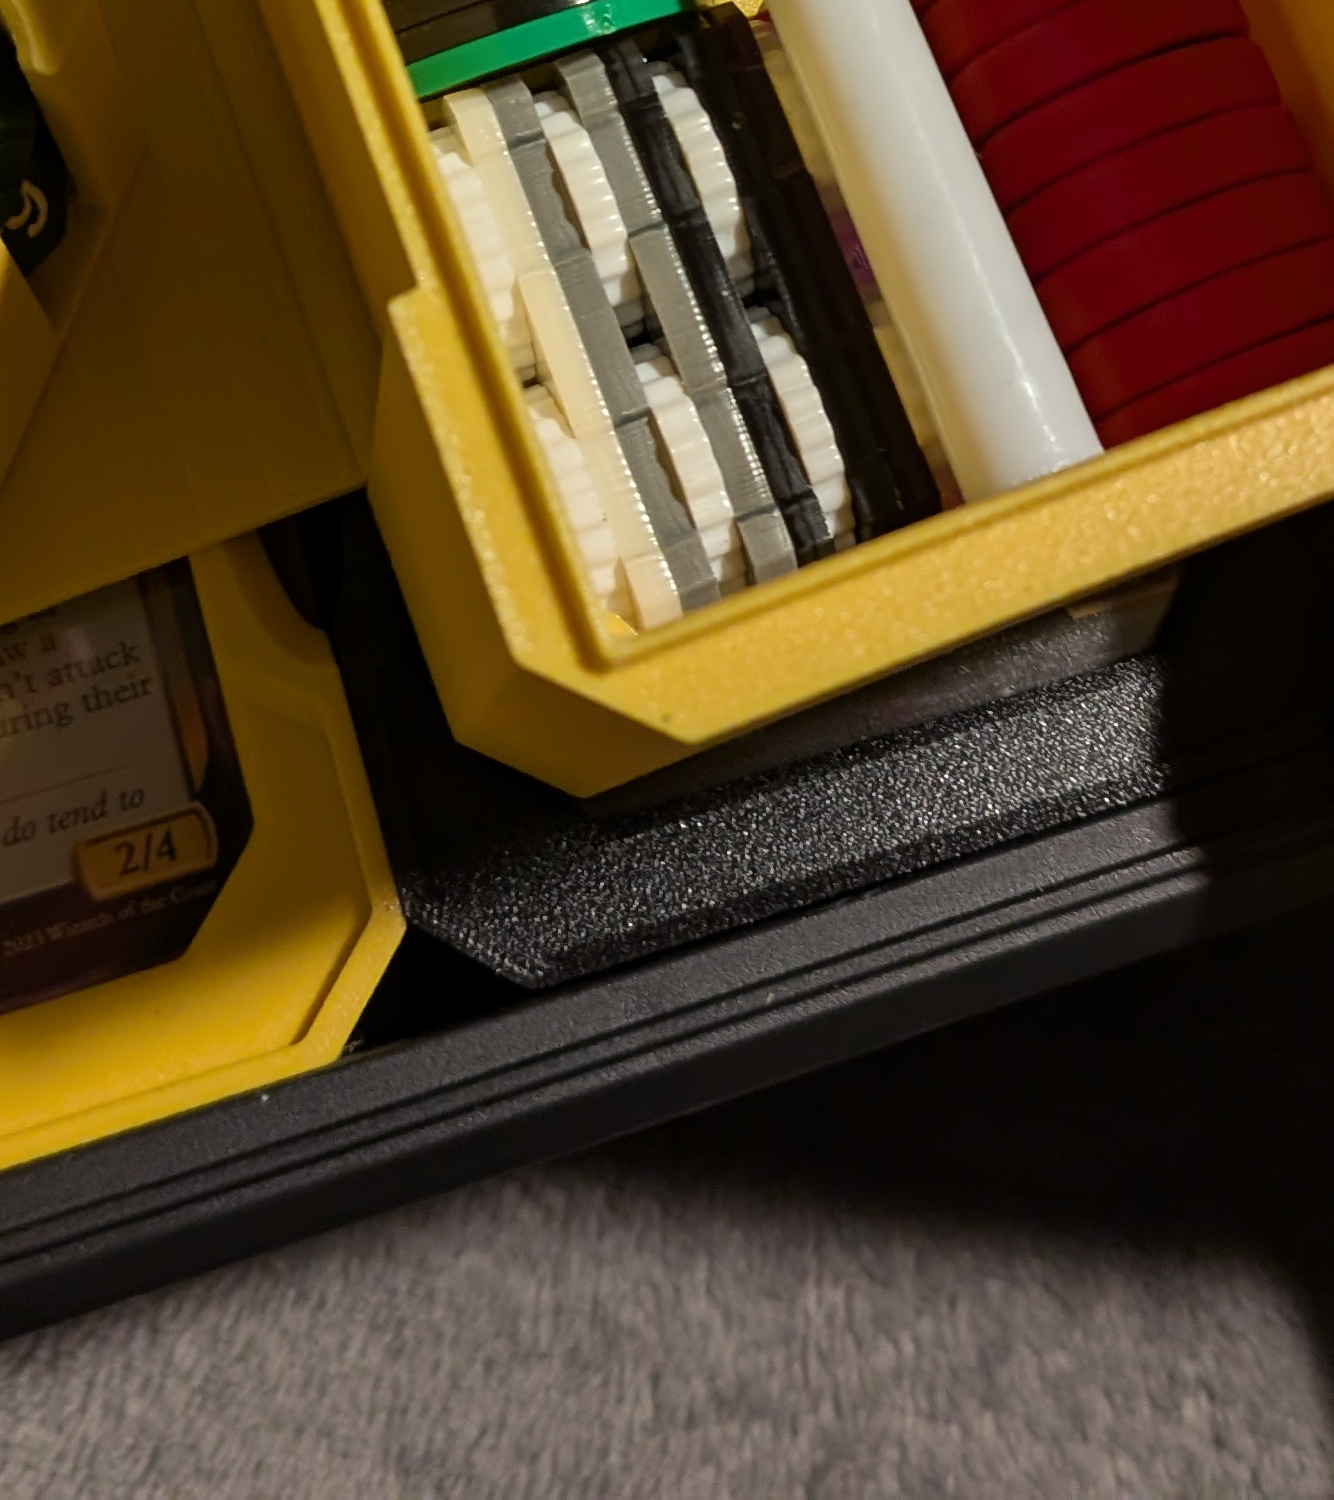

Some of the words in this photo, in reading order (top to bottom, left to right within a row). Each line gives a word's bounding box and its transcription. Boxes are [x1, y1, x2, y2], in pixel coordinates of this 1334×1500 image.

[42, 633, 58, 653] a
[47, 640, 142, 688] attack
[79, 672, 152, 715] their
[2, 818, 37, 848] do
[48, 790, 110, 835] tend
[118, 788, 144, 812] to
[114, 831, 178, 877] 2/4
